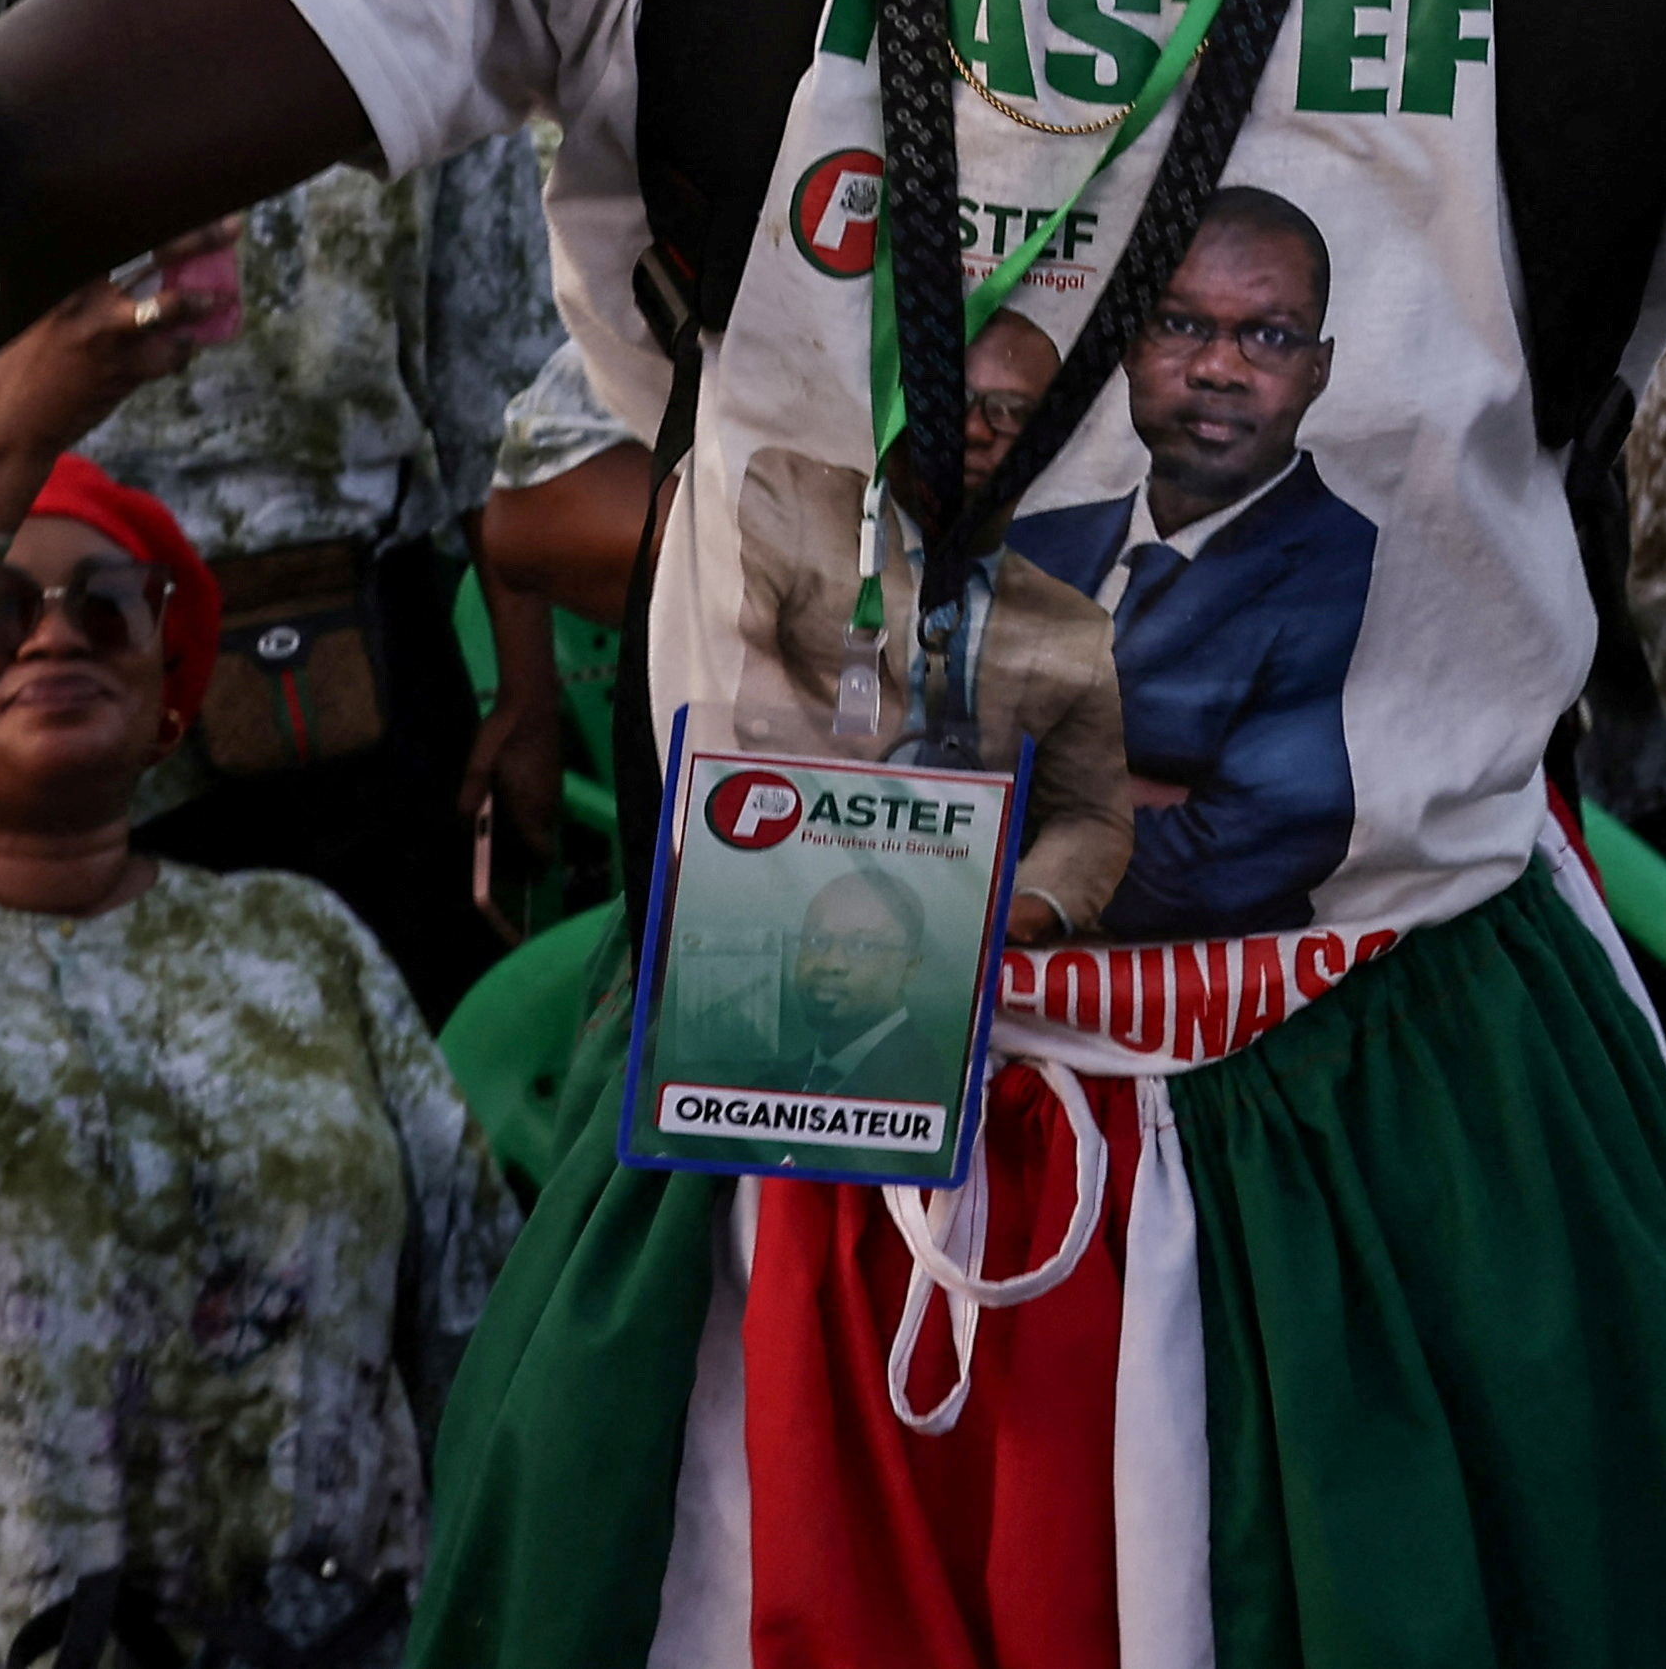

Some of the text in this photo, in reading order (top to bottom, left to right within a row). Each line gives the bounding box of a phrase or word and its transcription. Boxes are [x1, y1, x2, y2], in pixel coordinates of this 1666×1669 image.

[801, 830, 876, 850] Patriotes
[882, 839, 901, 852] du
[676, 1096, 931, 1141] ORGANISATEUR
